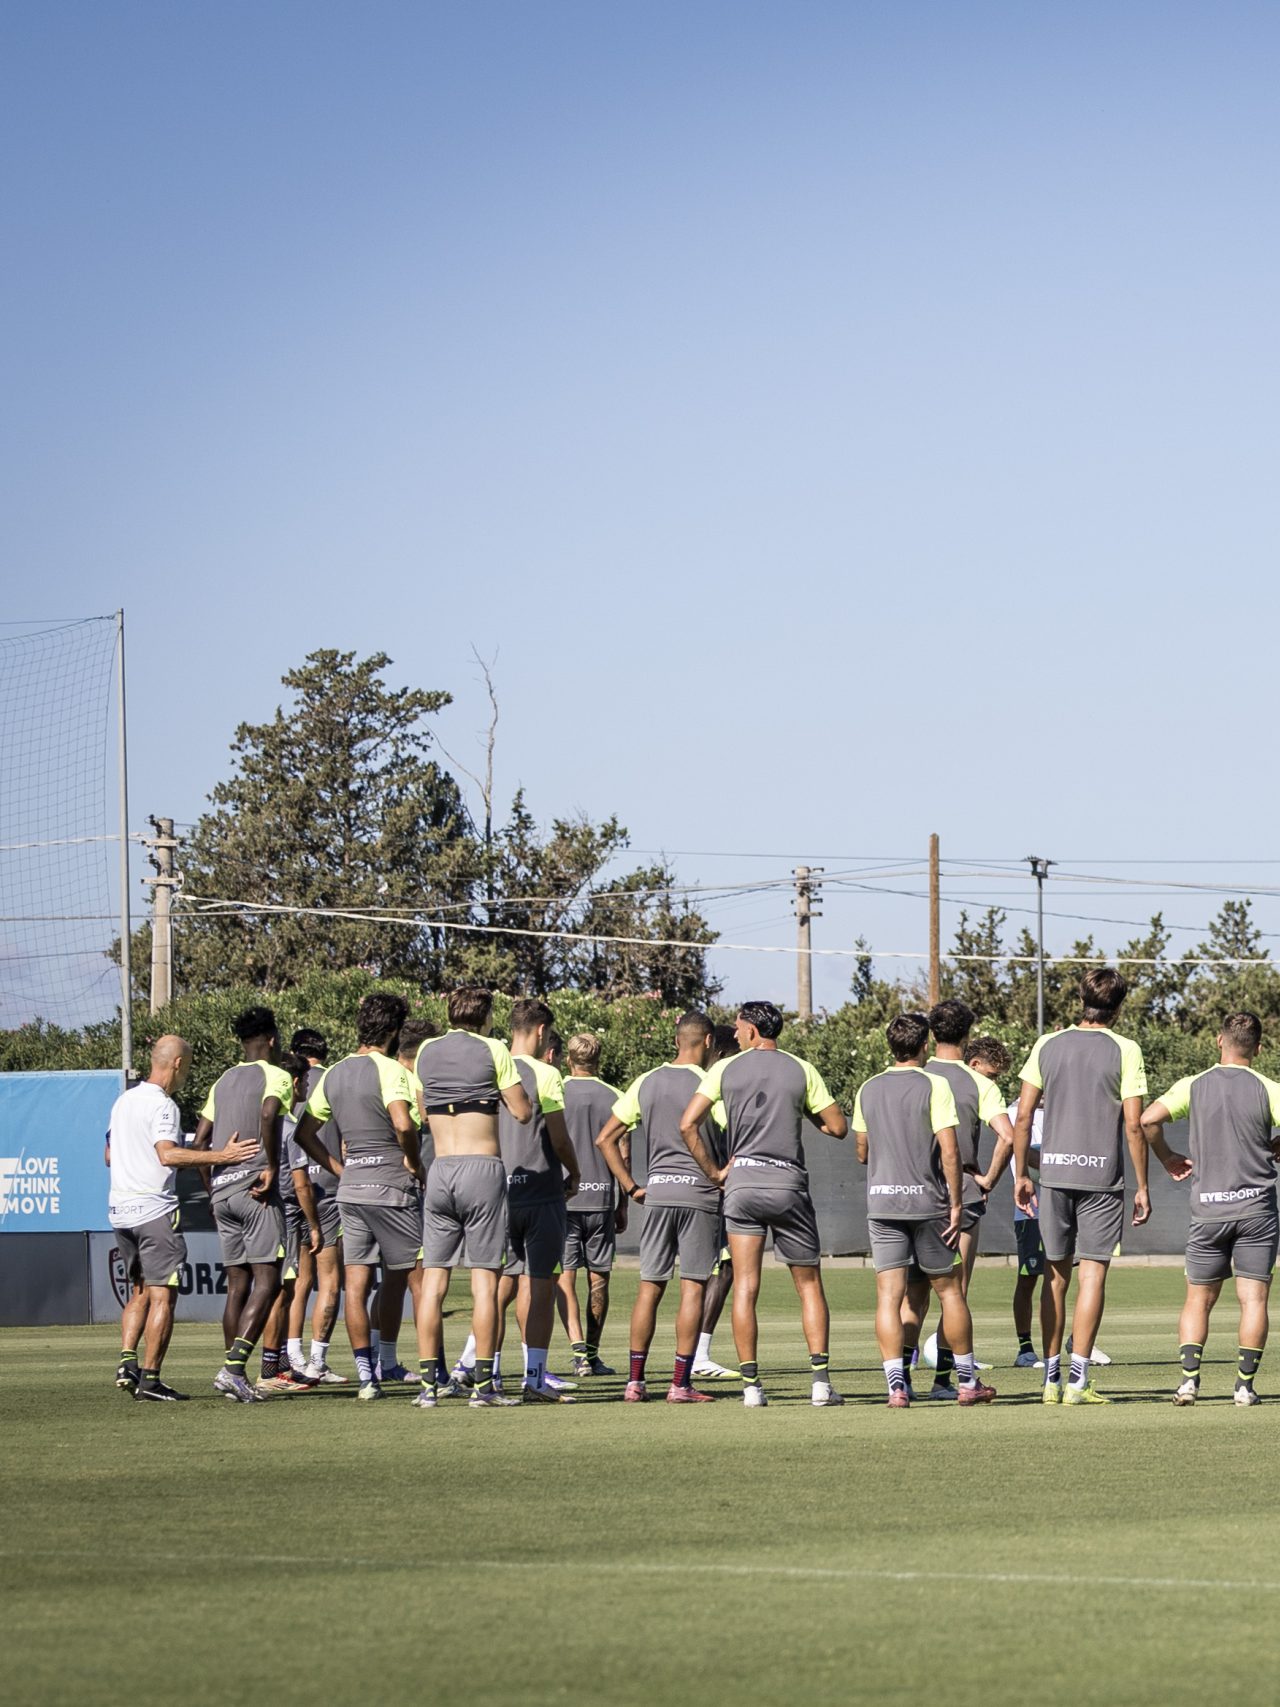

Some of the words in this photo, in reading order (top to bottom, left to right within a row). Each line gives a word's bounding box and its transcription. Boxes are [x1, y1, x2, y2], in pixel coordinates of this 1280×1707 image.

[17, 1157, 58, 1175] LOVE
[1042, 1153, 1107, 1168] EYESPORT
[12, 1178, 61, 1194] THINK
[578, 1182, 611, 1192] SPORT
[648, 1175, 699, 1186] YESPORT
[869, 1184, 925, 1196] EYESPORT
[1200, 1187, 1262, 1203] EYESPORT
[7, 1197, 60, 1214] MOVE
[177, 1262, 228, 1295] ORZ
